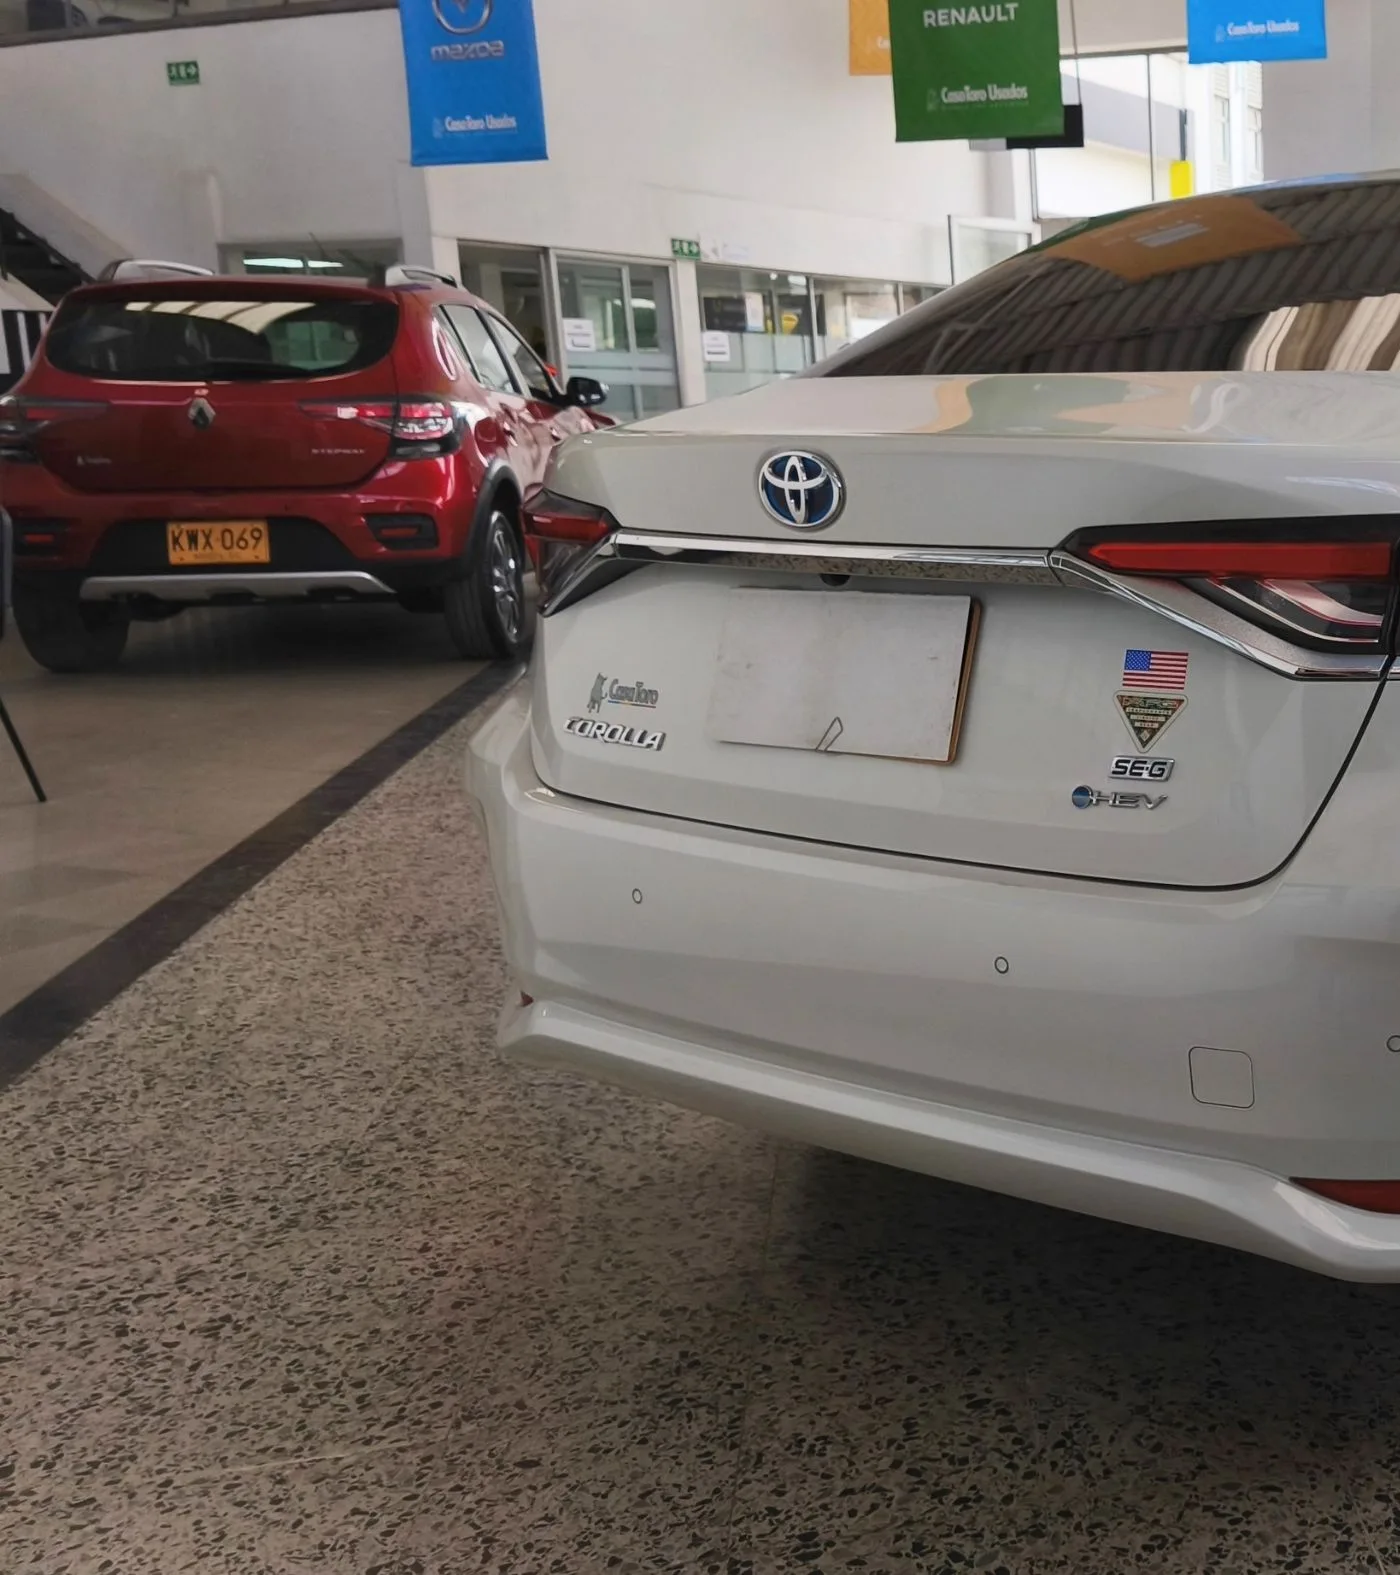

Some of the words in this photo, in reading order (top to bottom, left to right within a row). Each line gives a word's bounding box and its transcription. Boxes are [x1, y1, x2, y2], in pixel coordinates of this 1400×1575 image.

[923, 3, 1018, 28] RENAULT
[431, 40, 505, 60] mazda
[988, 82, 1028, 101] Usados
[171, 528, 213, 552] KWX
[221, 527, 263, 551] 069
[563, 716, 667, 751] COROLLA
[1091, 790, 1168, 810] HEV
